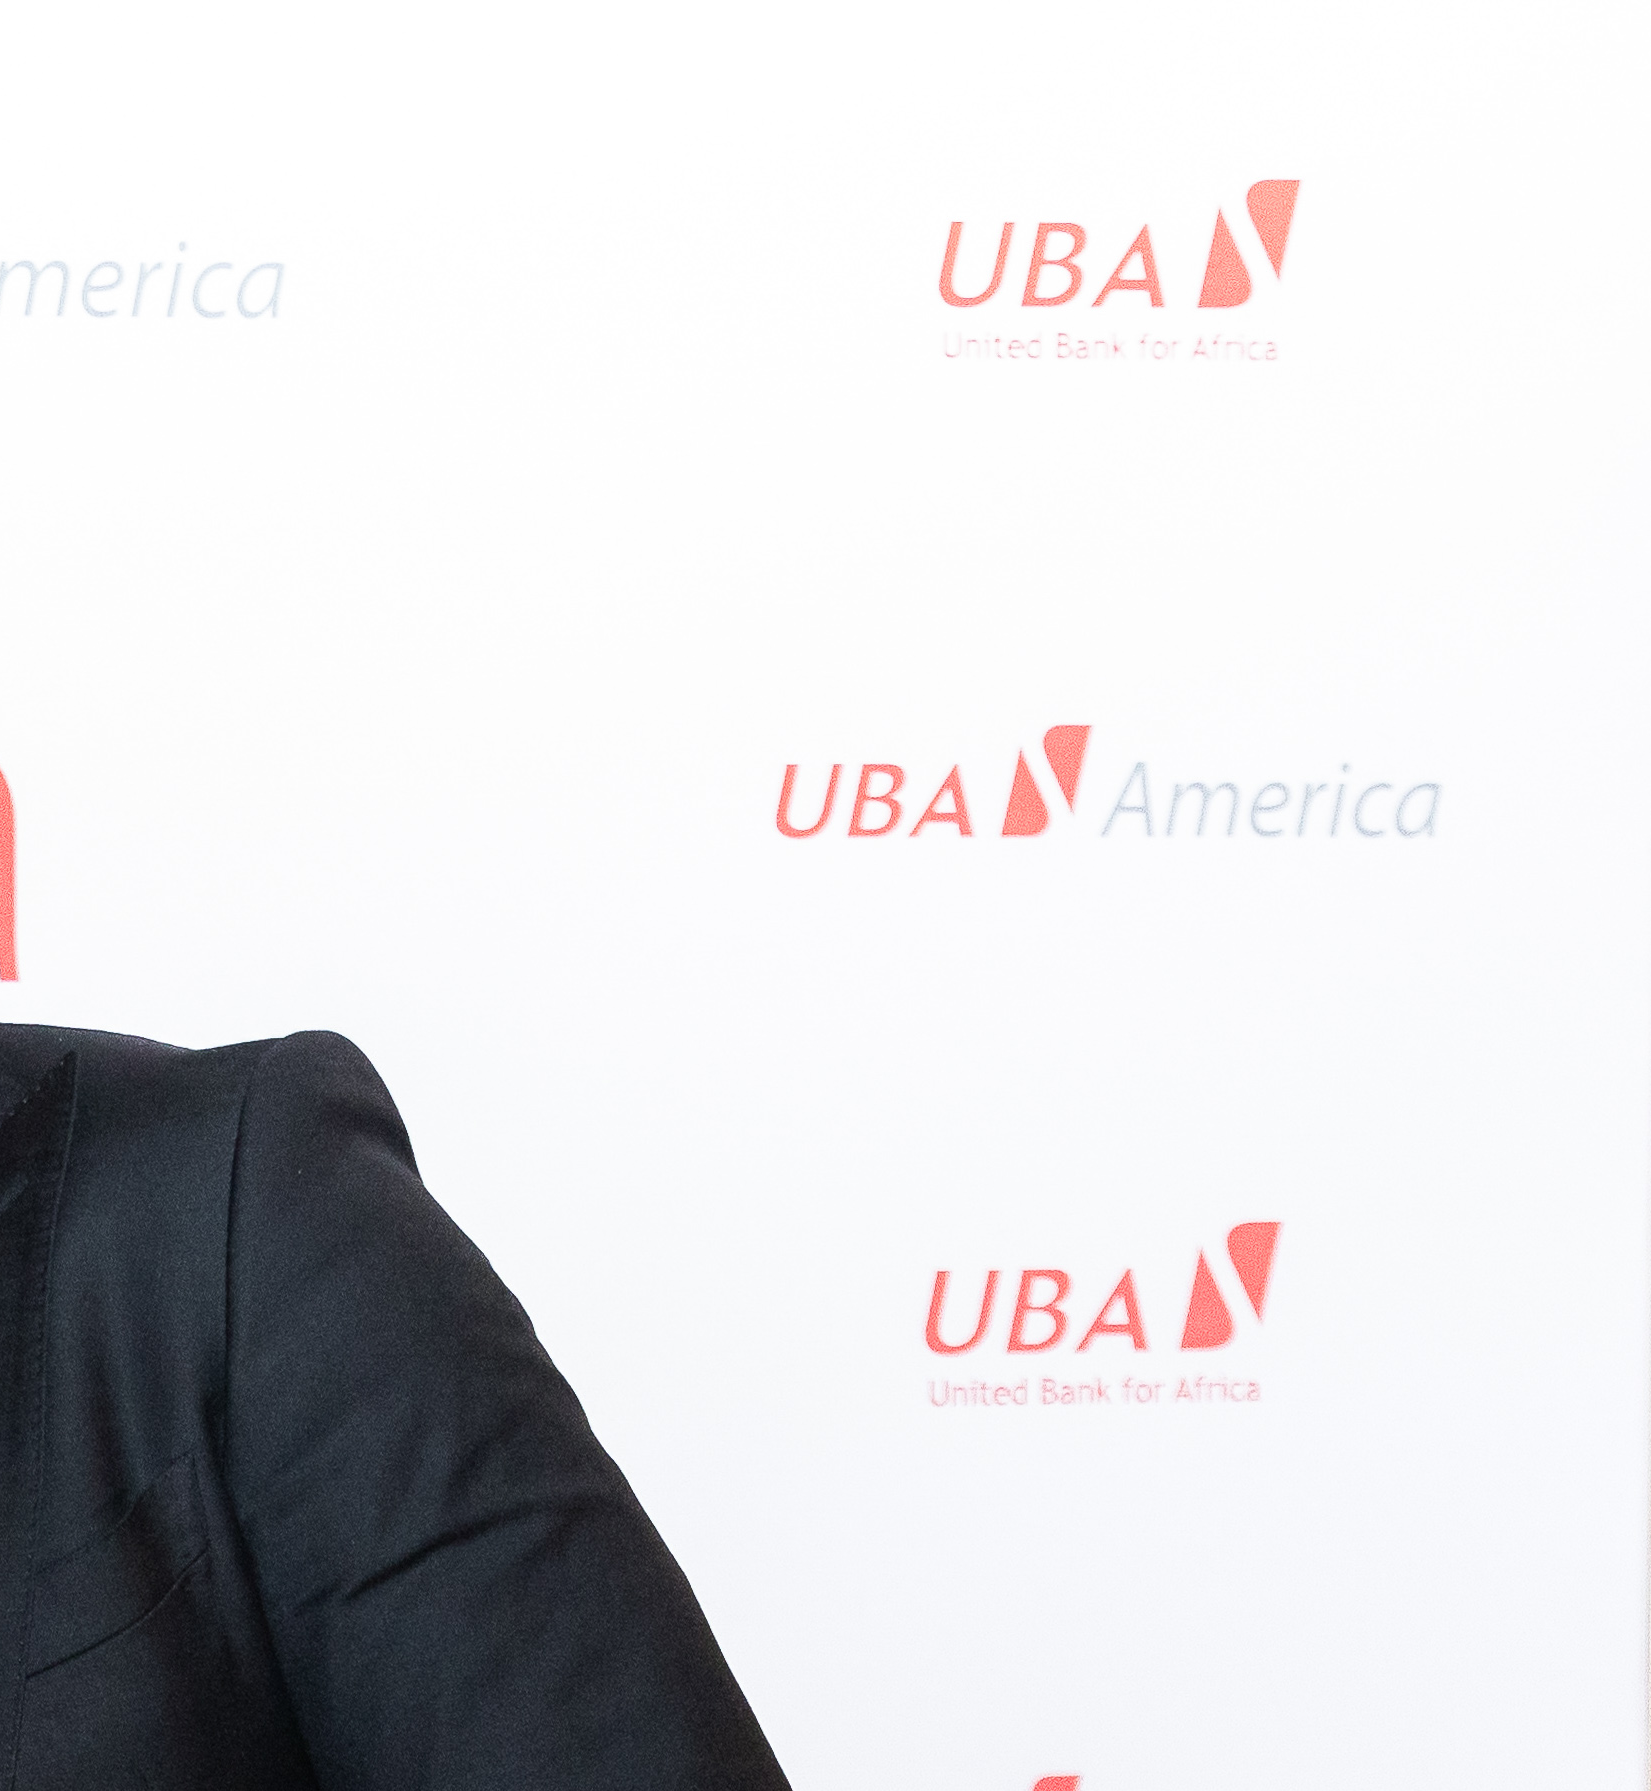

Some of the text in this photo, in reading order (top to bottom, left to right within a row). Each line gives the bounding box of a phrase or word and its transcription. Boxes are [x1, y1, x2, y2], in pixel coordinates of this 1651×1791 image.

[937, 219, 1166, 309] UBA
[942, 332, 1280, 364] United Bank for Africa
[774, 759, 1444, 841] UBA America
[923, 1267, 1149, 1357] UBA
[928, 1375, 1261, 1408] United Bank for Africa
